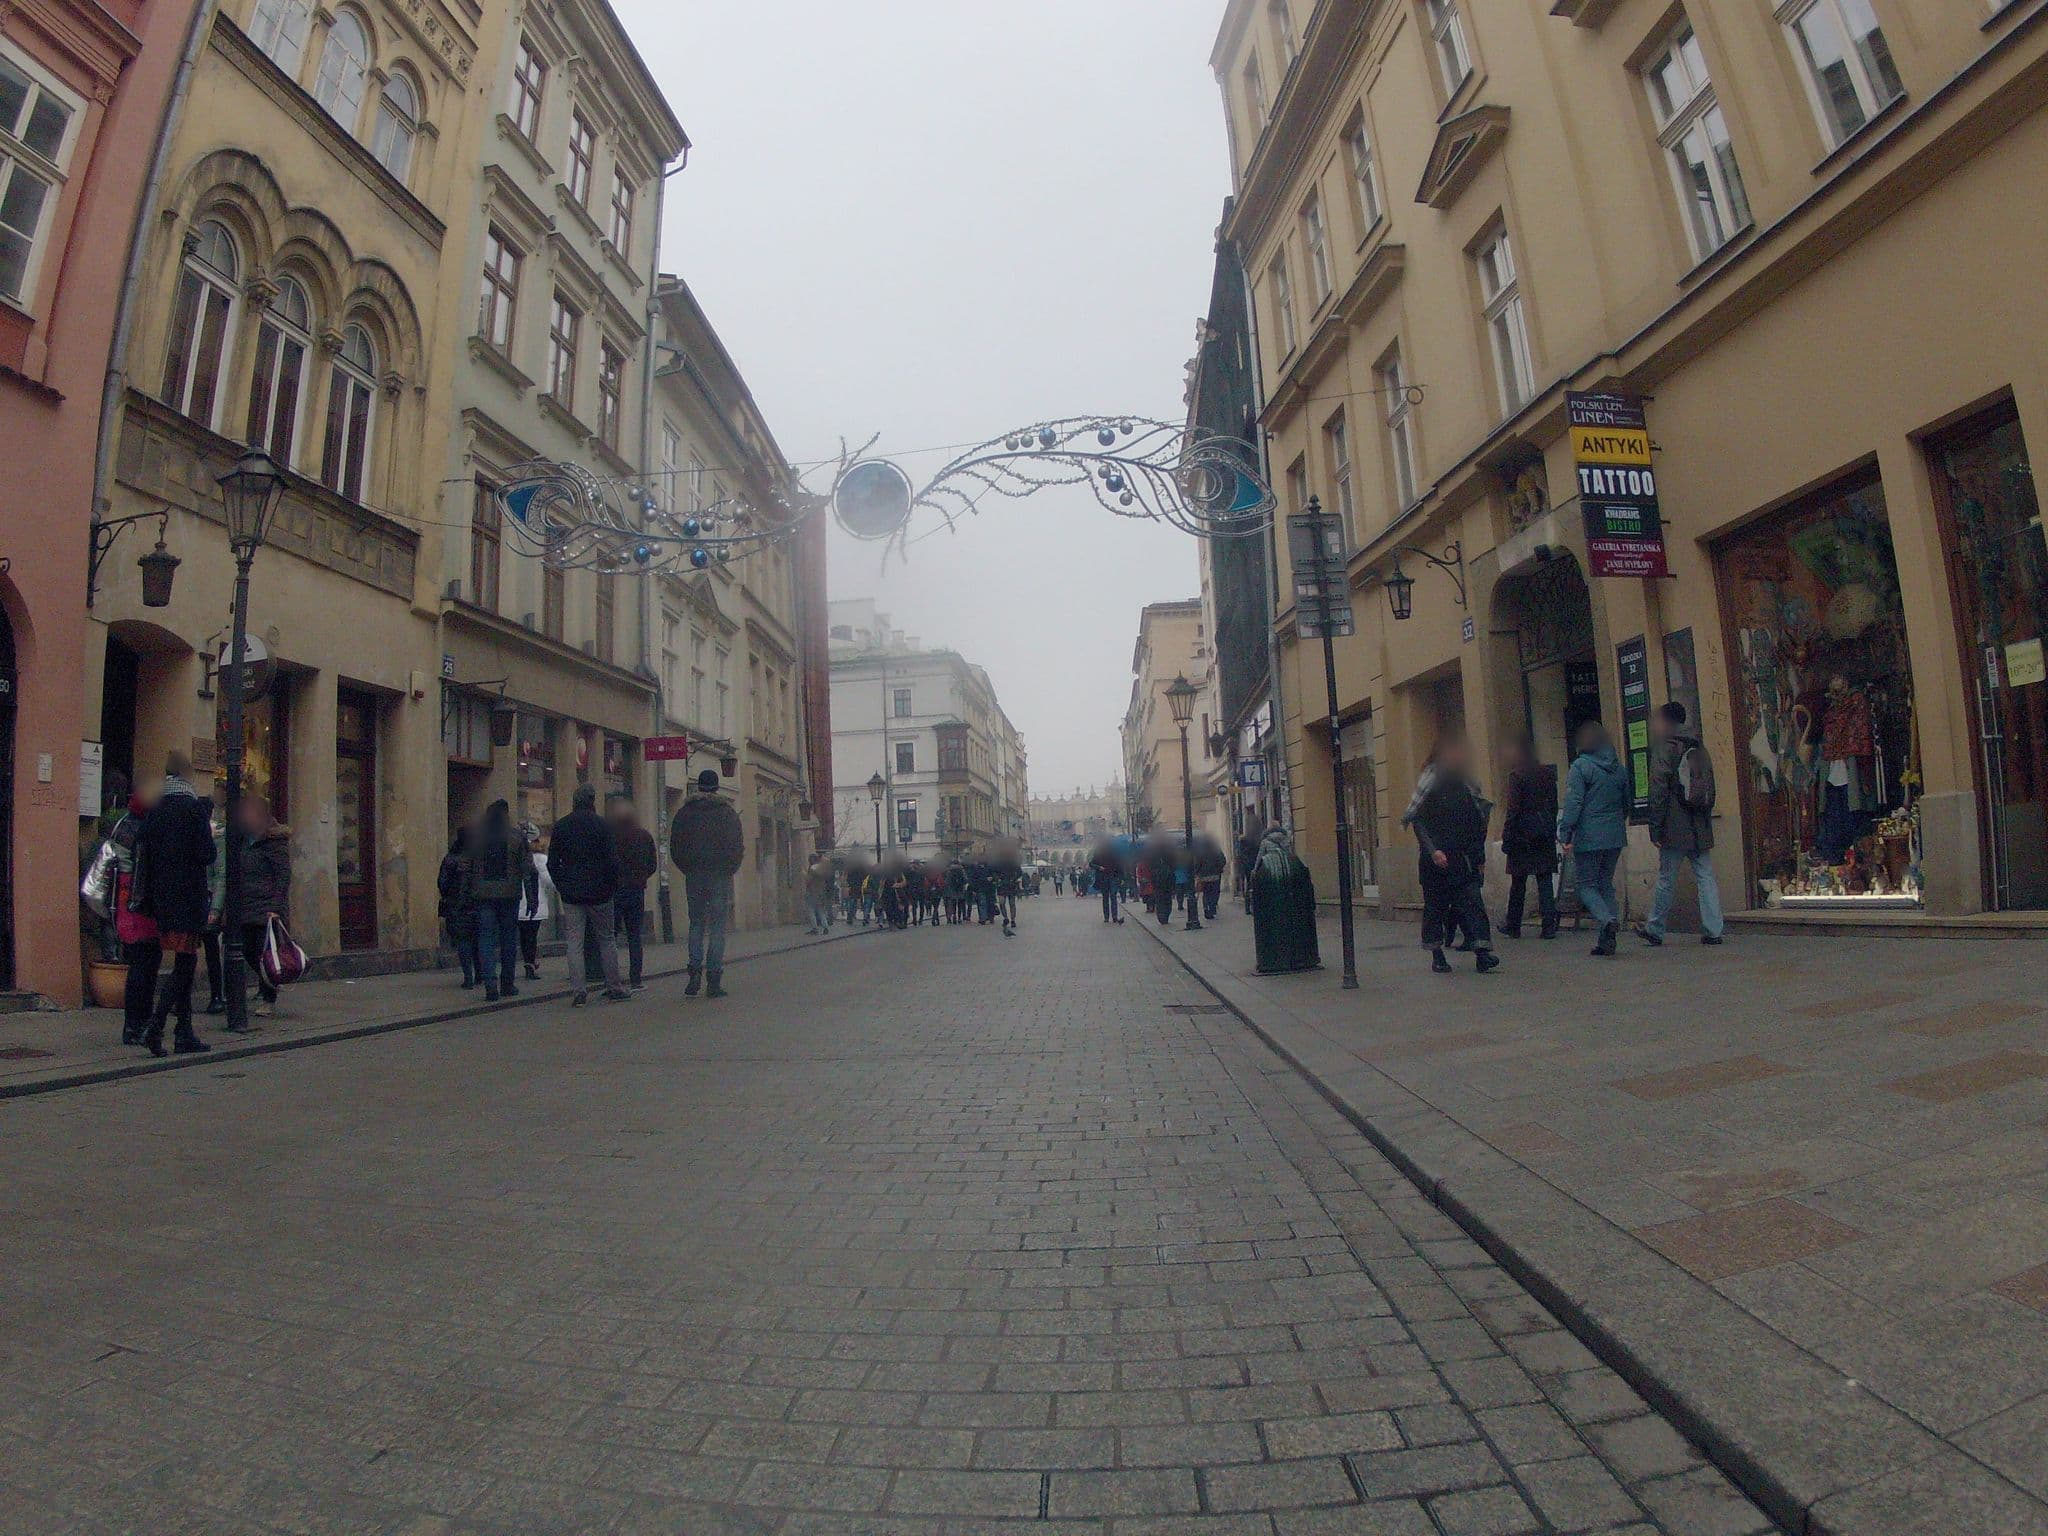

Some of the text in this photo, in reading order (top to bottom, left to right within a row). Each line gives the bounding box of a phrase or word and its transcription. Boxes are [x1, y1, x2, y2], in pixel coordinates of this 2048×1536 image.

[1571, 400, 1623, 411] POLSKI LEN
[1572, 411, 1615, 424] LINEN
[1582, 436, 1645, 455] ANTYKI
[1579, 468, 1655, 496] TATTOO
[1606, 520, 1641, 531] BISTRO
[1592, 543, 1621, 552] GALERIA
